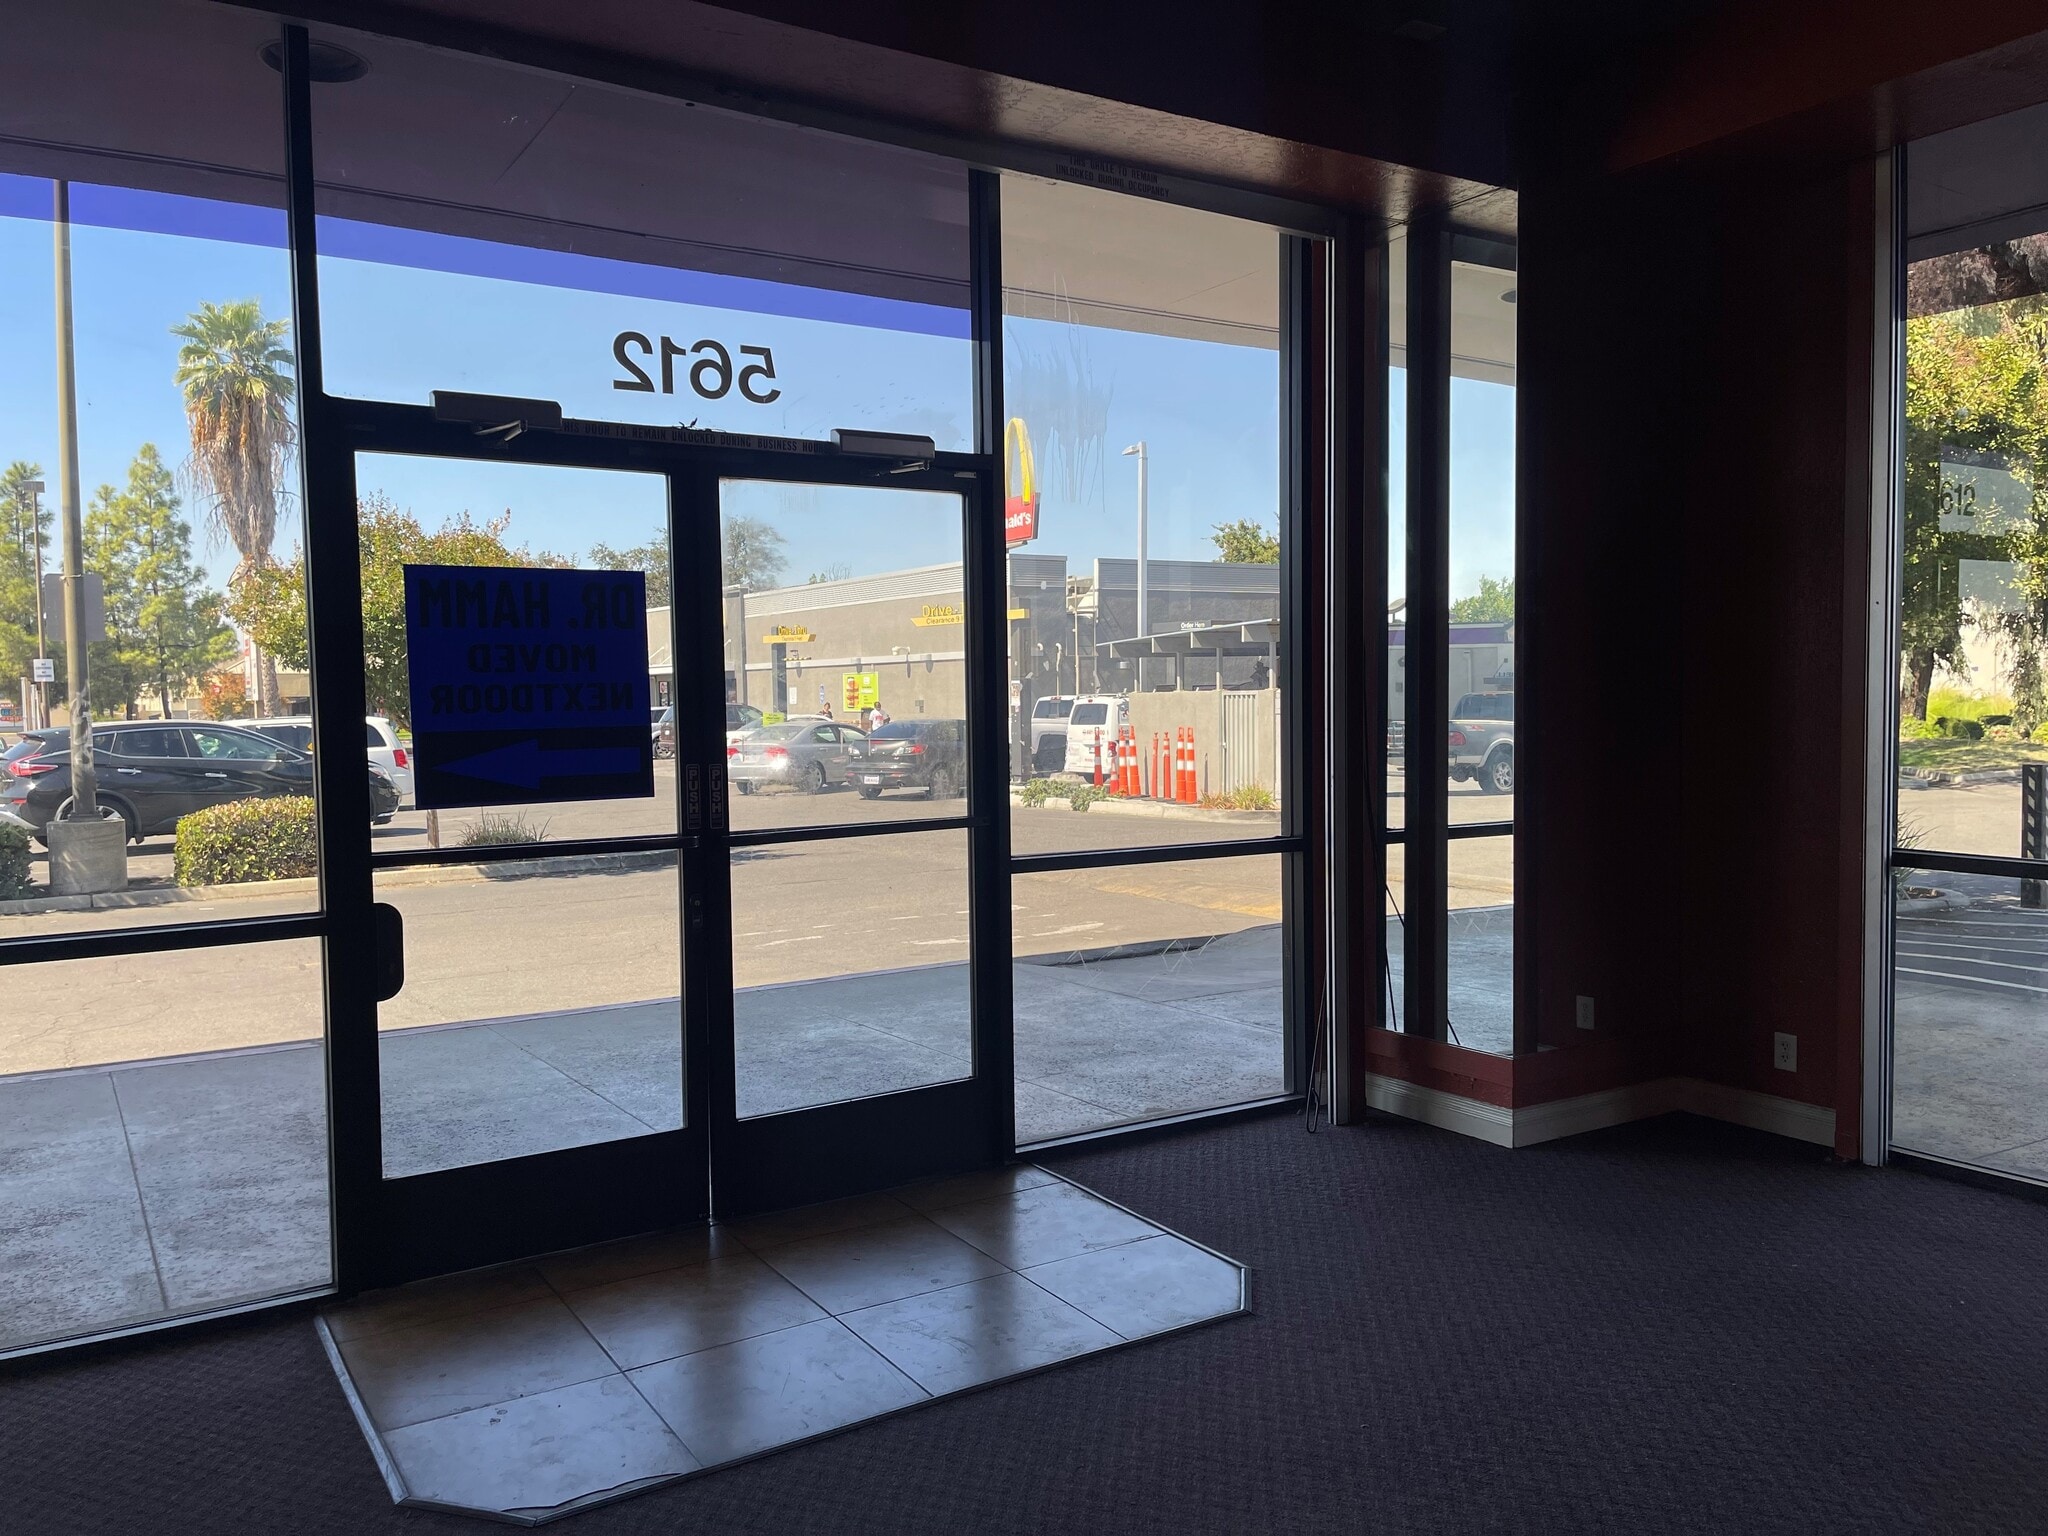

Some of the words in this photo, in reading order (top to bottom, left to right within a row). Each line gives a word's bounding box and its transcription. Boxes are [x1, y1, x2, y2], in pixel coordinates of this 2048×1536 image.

[1055, 163, 1094, 181] UNLOCKED
[1098, 173, 1125, 189] DURING
[1128, 180, 1170, 198] OCCUPANCY
[1069, 155, 1086, 167] THIS
[1118, 165, 1128, 177] TO
[1131, 167, 1158, 184] REMAIN
[562, 421, 580, 433] HIS
[584, 423, 610, 436] DOOR
[615, 425, 627, 437] TO
[632, 427, 666, 440] REMAIN
[671, 430, 716, 444] UNLOCKED
[720, 434, 752, 448] DURING
[757, 438, 798, 452] BUSINESS
[926, 616, 955, 625] Clearance
[688, 769, 700, 814] PUSH
[711, 769, 722, 814] PUSH
